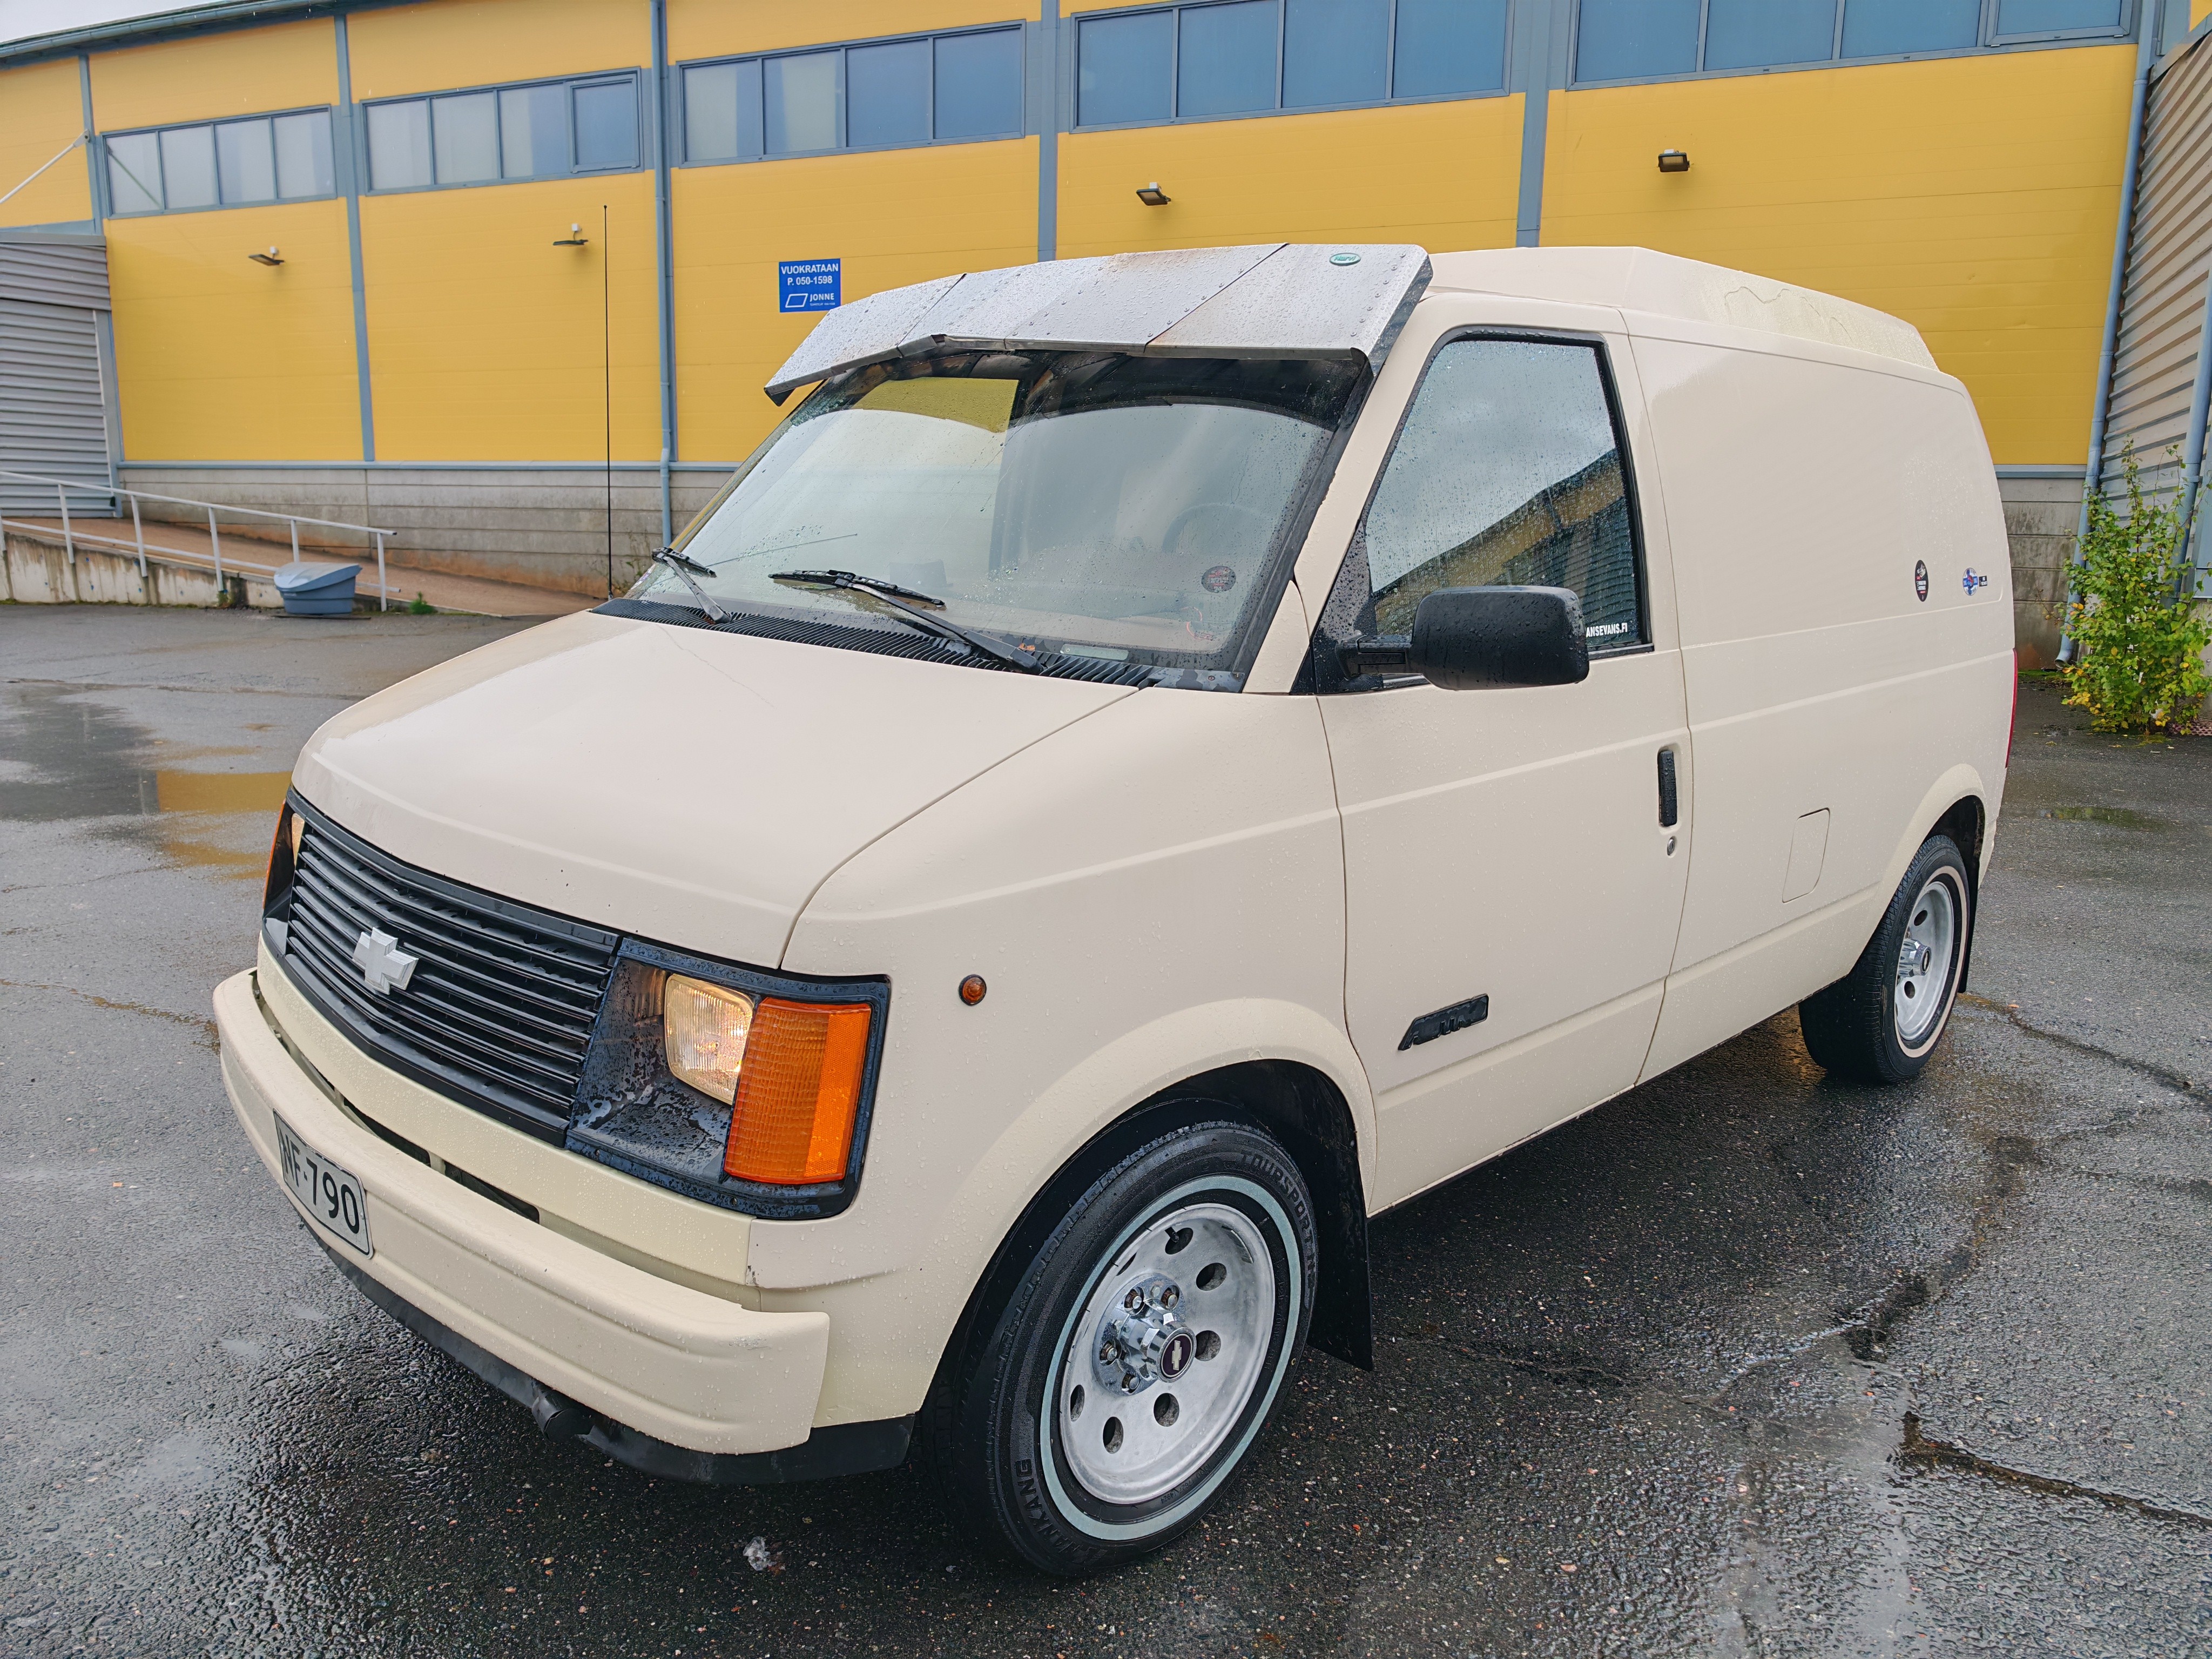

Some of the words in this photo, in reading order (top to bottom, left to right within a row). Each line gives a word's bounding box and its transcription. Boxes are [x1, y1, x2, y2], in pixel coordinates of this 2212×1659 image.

[781, 264, 839, 274] VUOKRATAAN
[787, 278, 794, 286] P.
[796, 275, 833, 285] 050-1598
[810, 293, 834, 302] JONNE
[1586, 622, 1628, 637] ANSEVANS.FI
